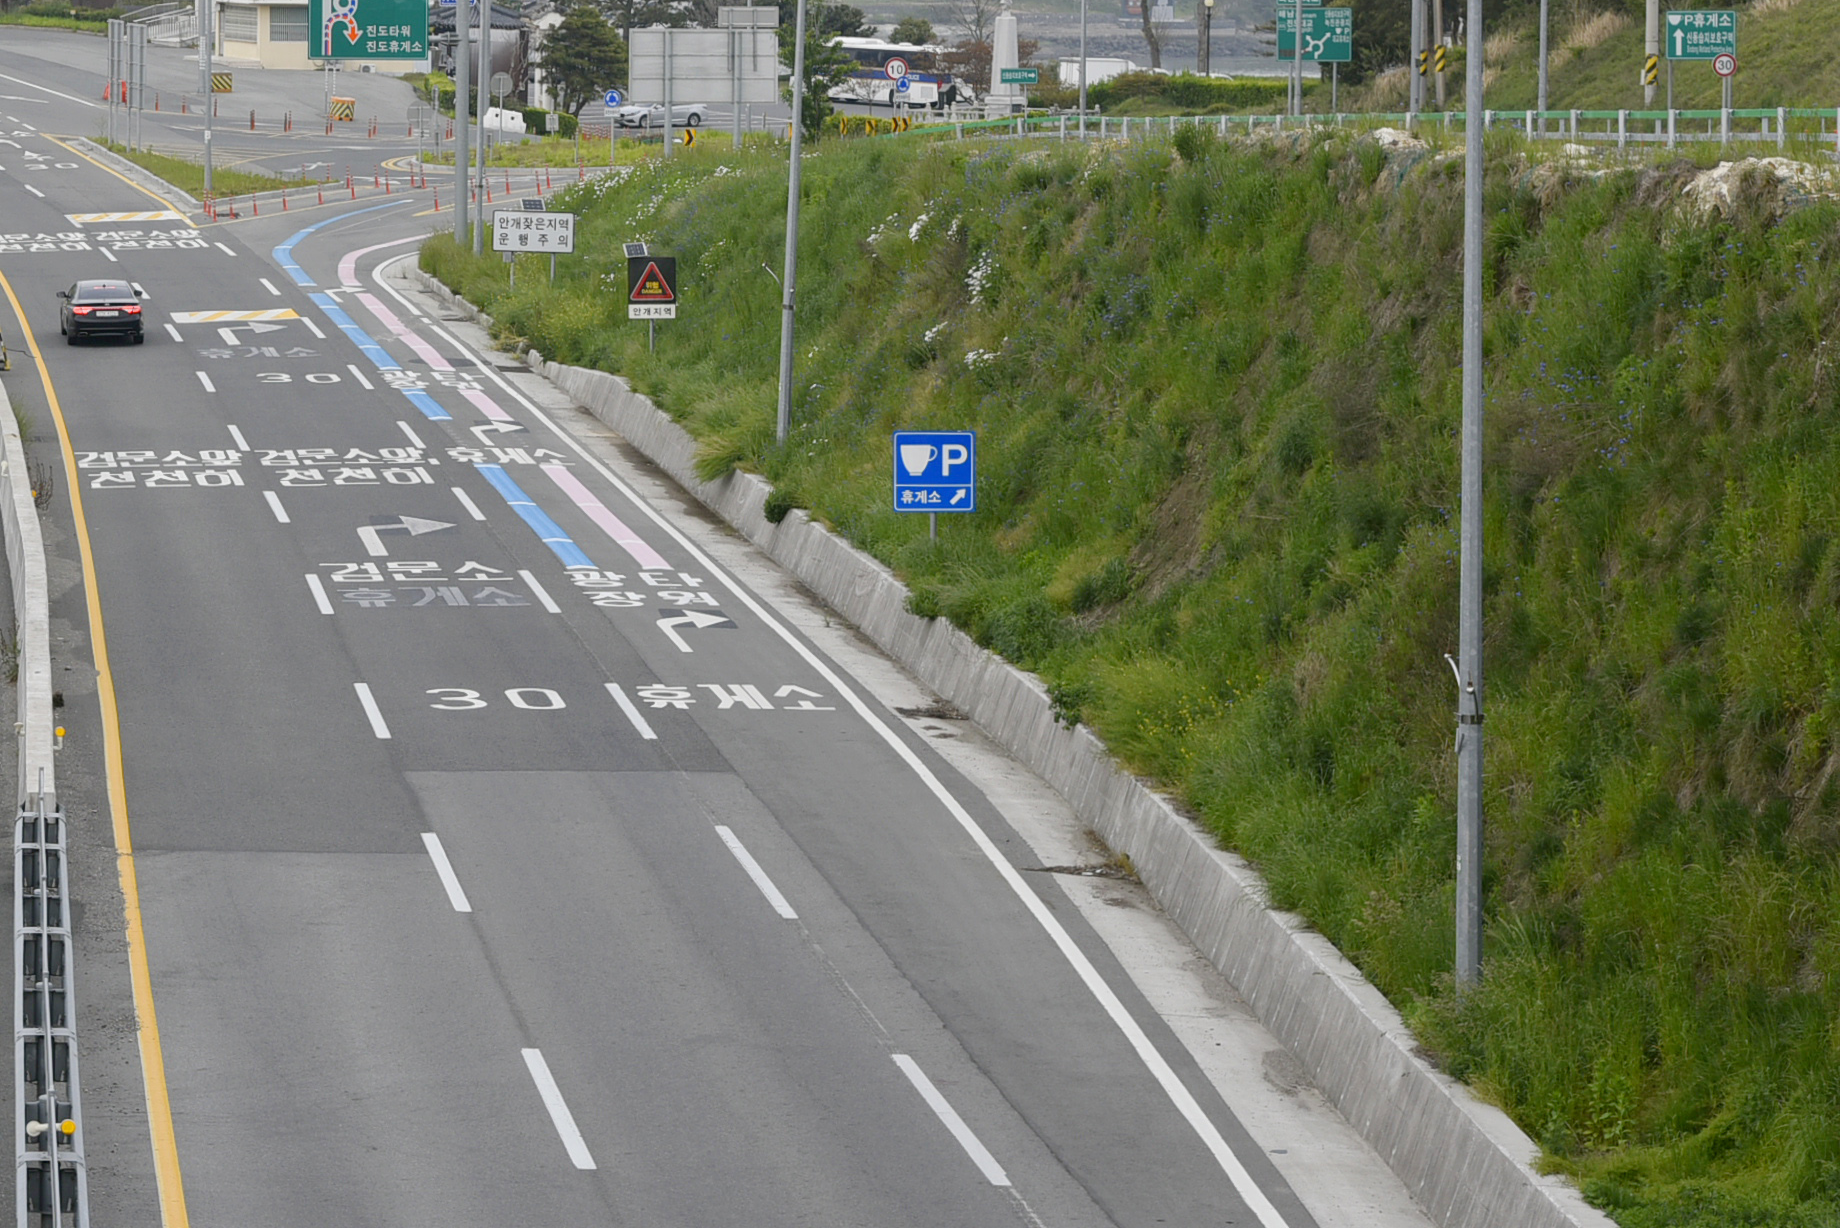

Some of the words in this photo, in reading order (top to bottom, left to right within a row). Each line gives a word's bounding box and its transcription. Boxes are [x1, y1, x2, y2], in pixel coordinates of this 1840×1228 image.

[366, 25, 411, 37] 진도타워
[366, 41, 423, 52] 진도휴게소
[890, 64, 904, 75] 10
[1717, 59, 1732, 71] 30
[24, 162, 80, 171] 30
[498, 216, 570, 231] 안개잦은지역
[498, 232, 569, 247] 운행주의
[632, 306, 673, 317] 안개지역
[197, 346, 322, 360] 휴게소
[256, 372, 342, 384] 30
[74, 450, 243, 469] 검문소앞
[254, 447, 426, 466] 검문소앞
[445, 446, 575, 465] 휴게소
[942, 444, 968, 476] P
[91, 469, 245, 489] 천천히
[280, 466, 435, 487] 천천히
[901, 489, 942, 505] 휴게소
[319, 560, 515, 583] 검문소
[337, 585, 533, 608] 휴게소
[425, 687, 567, 710] 30
[635, 682, 837, 711] 휴게소
